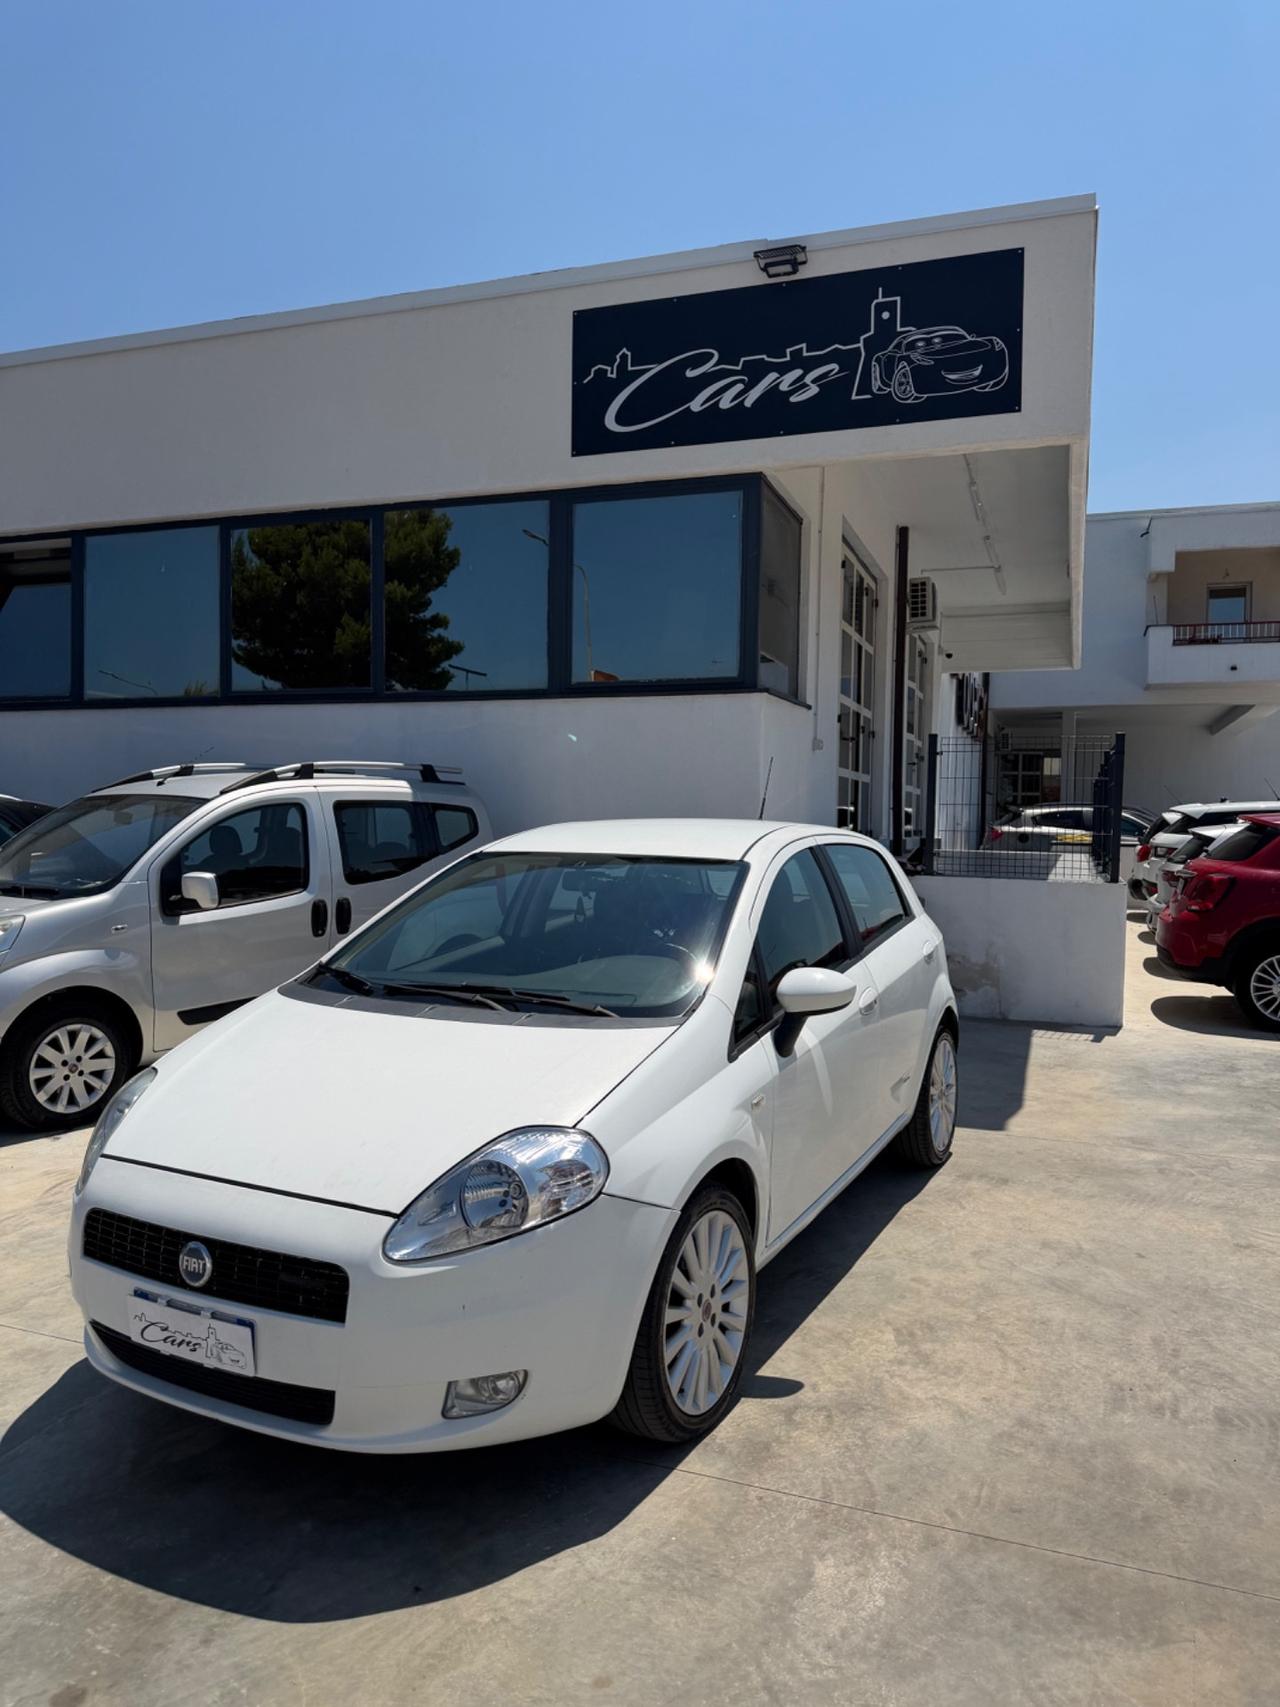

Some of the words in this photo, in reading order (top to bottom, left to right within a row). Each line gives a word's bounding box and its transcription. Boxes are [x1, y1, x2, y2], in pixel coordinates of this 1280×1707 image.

[605, 348, 848, 432] Cars
[183, 1256, 206, 1274] FIAT
[141, 1322, 202, 1352] Cars
